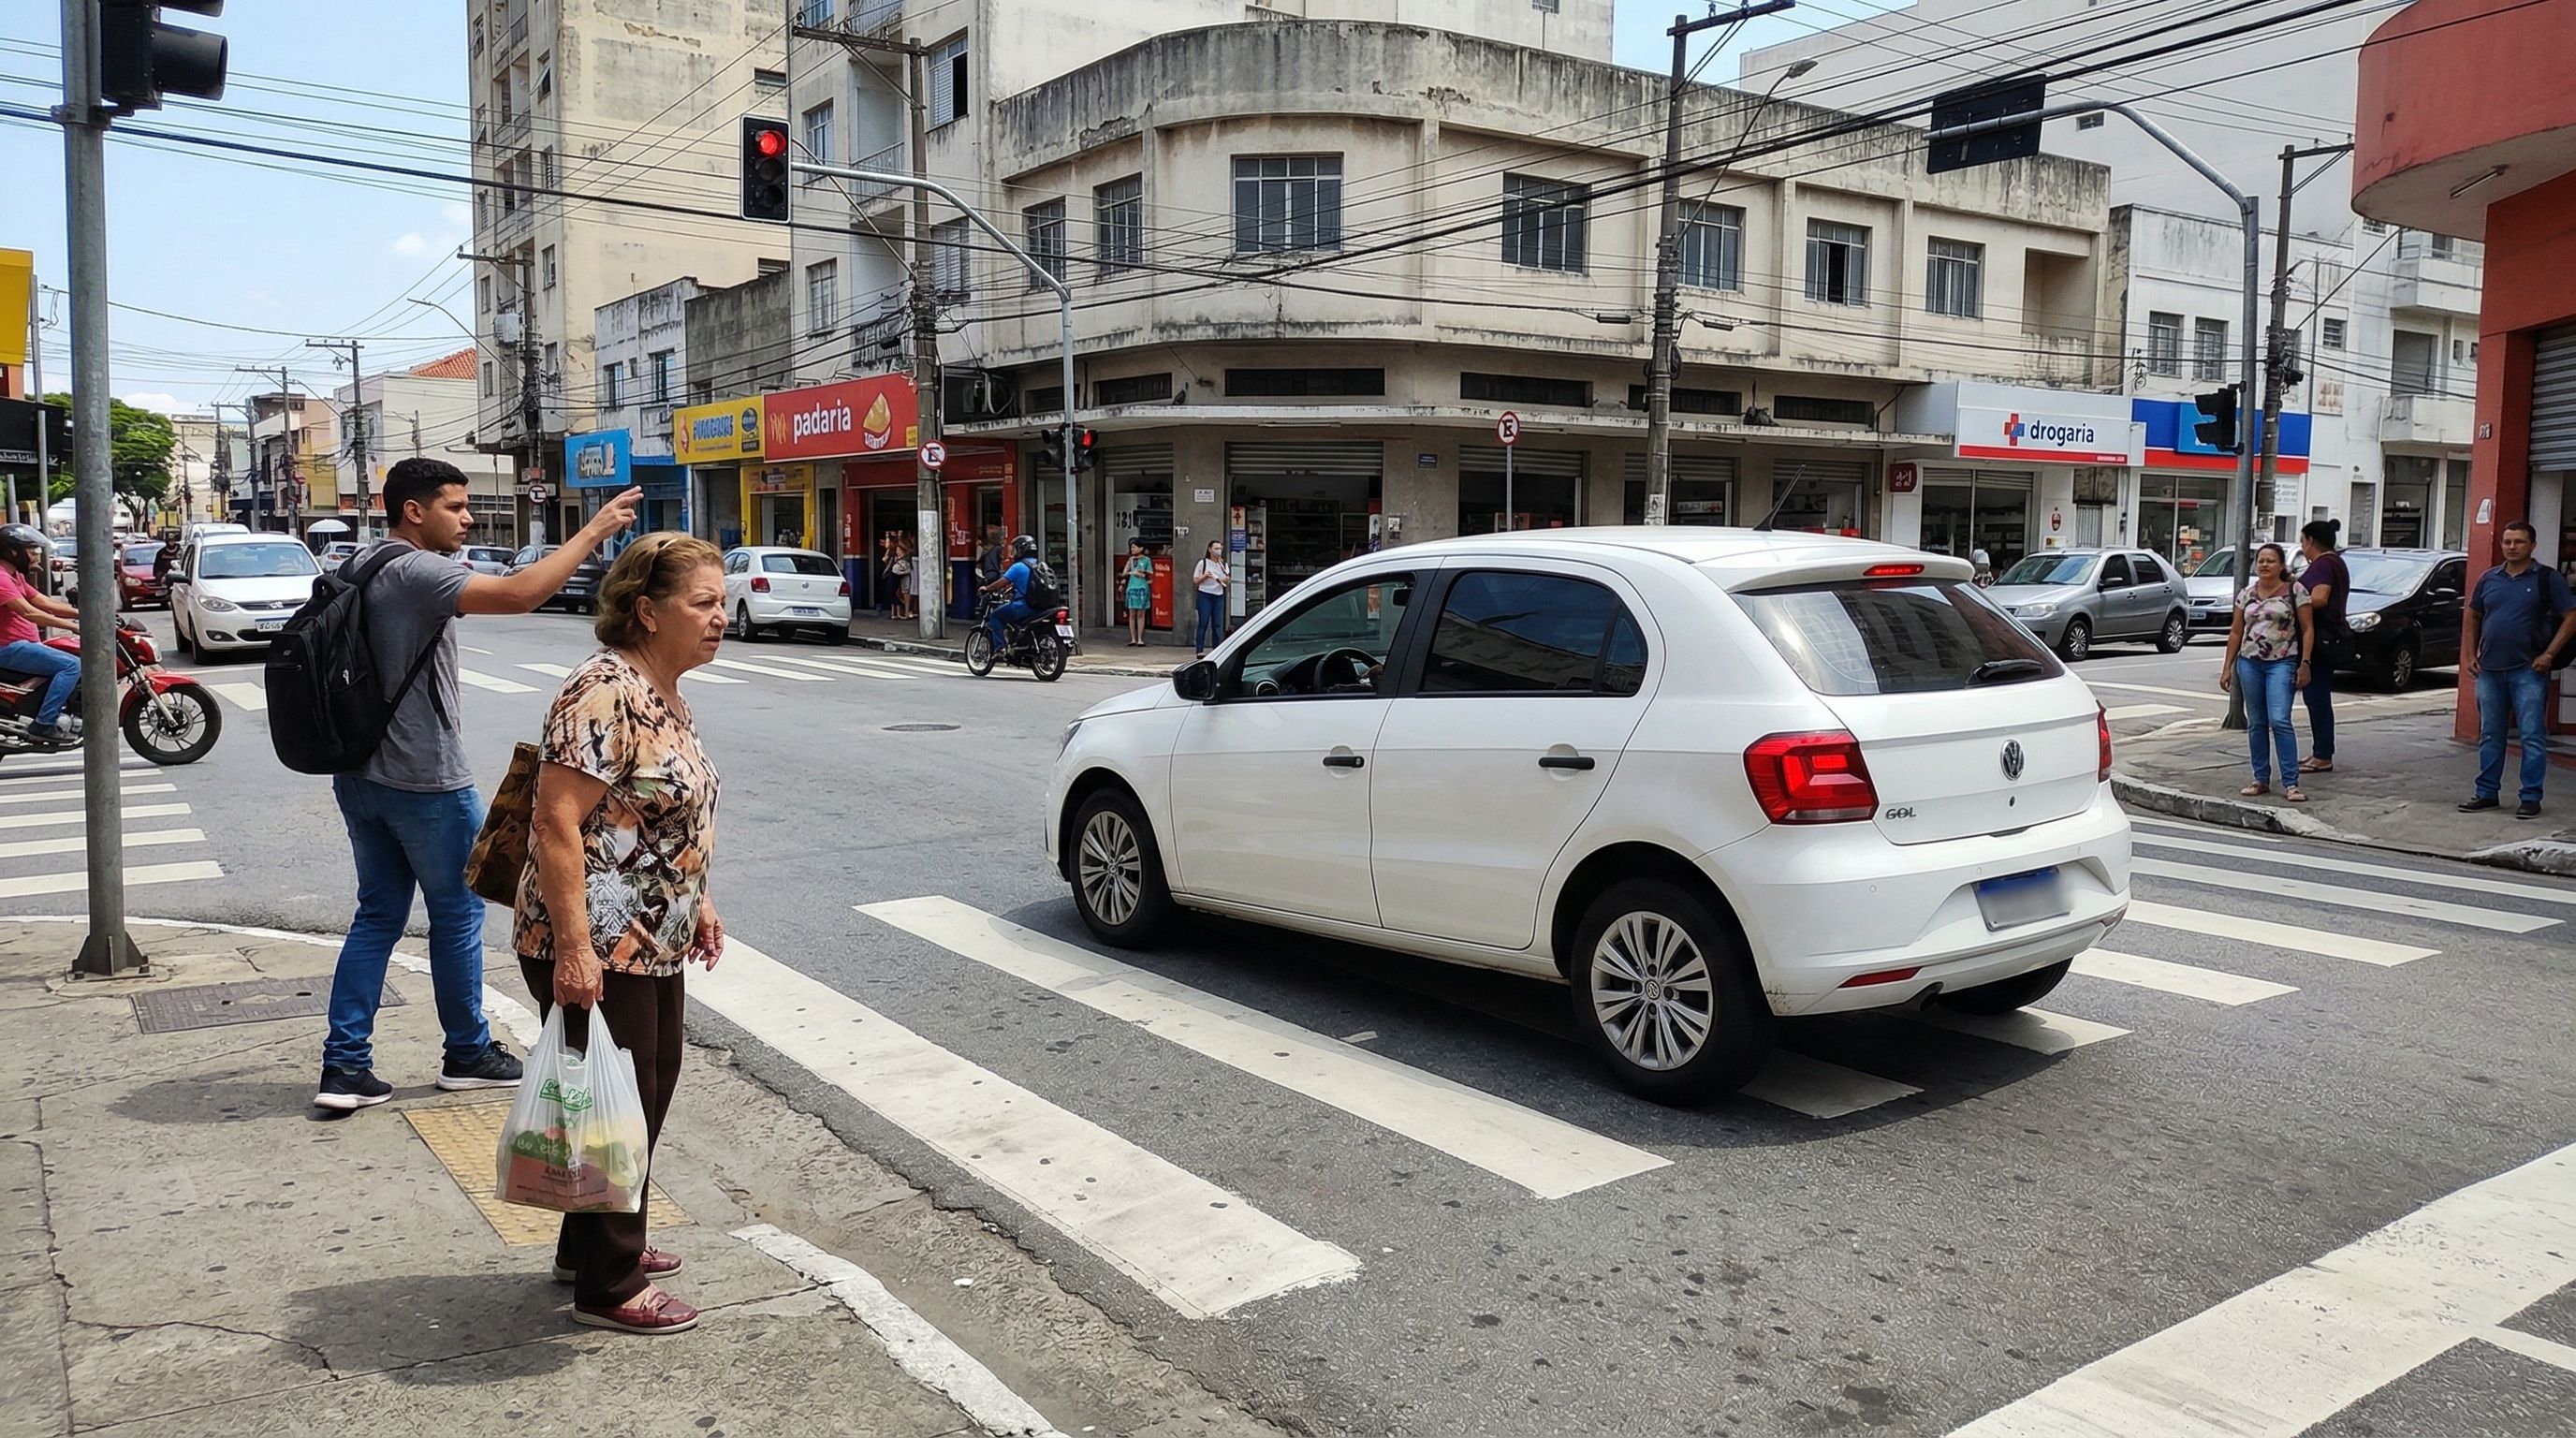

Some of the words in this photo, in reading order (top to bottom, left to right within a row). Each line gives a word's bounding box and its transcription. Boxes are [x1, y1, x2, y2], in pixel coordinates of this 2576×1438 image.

[794, 398, 851, 445] padaria
[2030, 419, 2094, 447] drogaria
[1885, 806, 1917, 820] GOL
